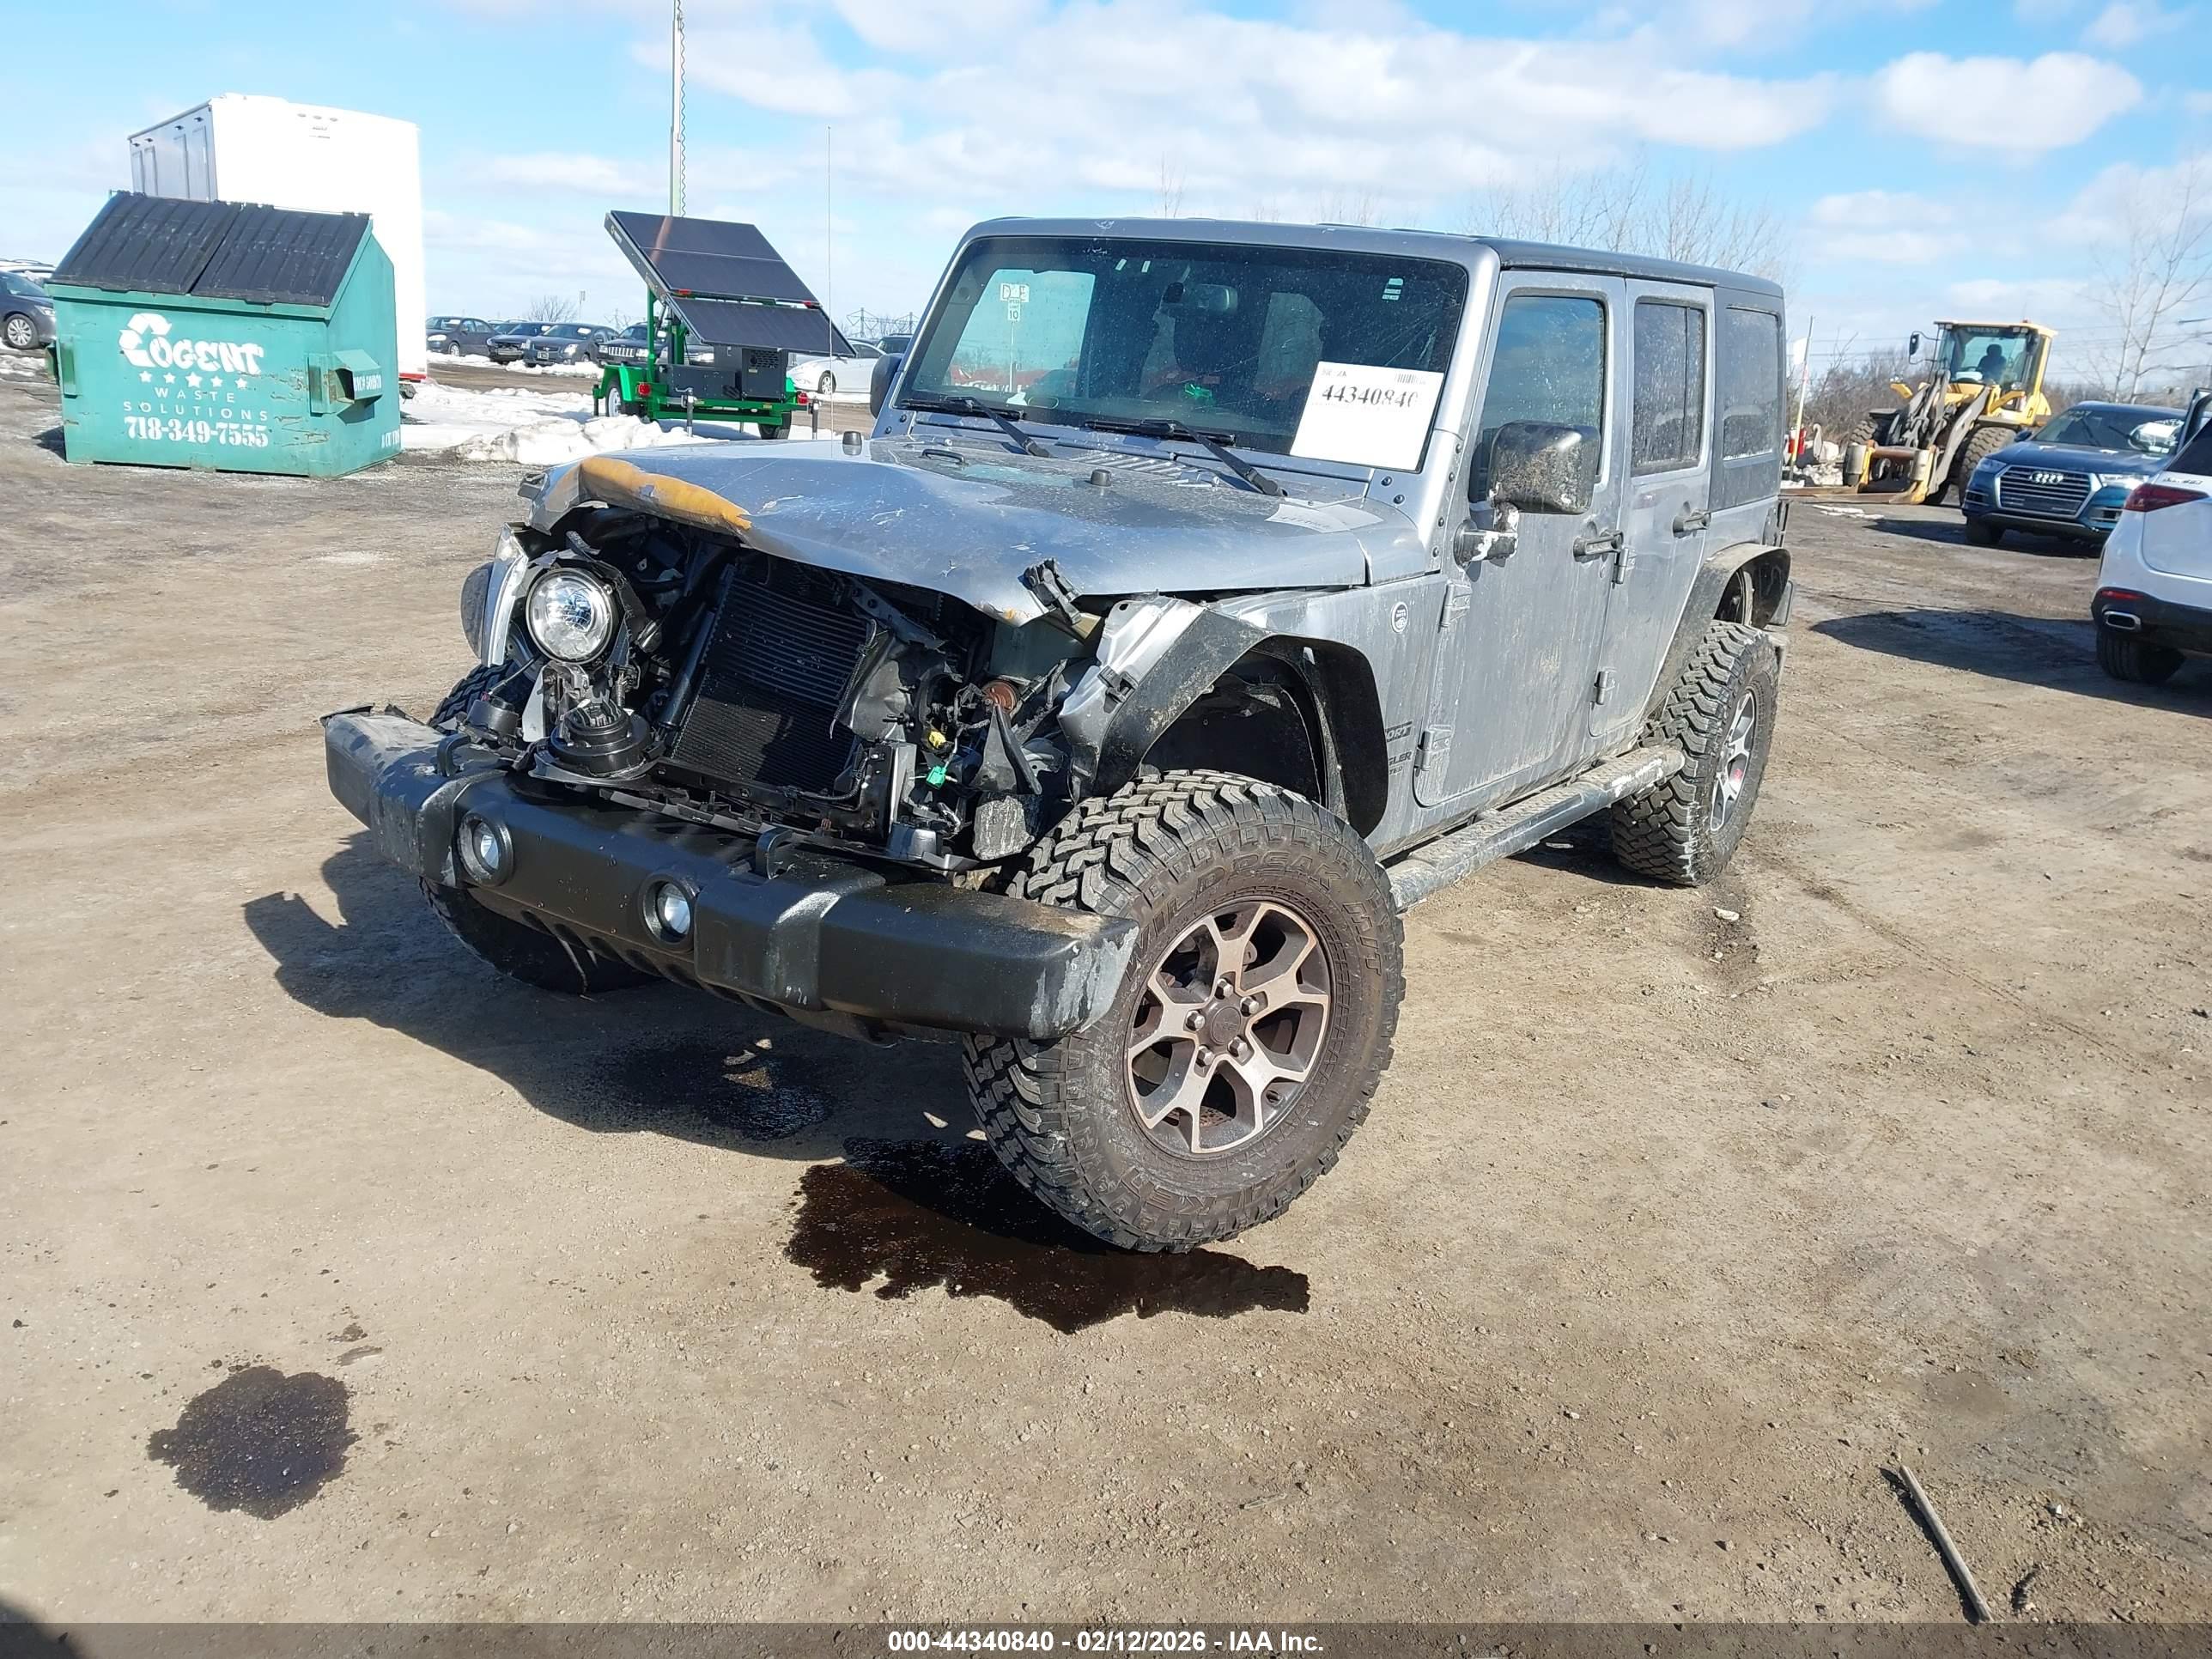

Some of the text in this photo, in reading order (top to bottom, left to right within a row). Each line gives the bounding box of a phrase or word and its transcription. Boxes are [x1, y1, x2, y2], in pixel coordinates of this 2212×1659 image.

[1009, 309, 1019, 319] 10
[155, 386, 236, 404] WASTE
[123, 400, 268, 422] SOLUTIONS
[124, 416, 269, 448] 718-349-7555
